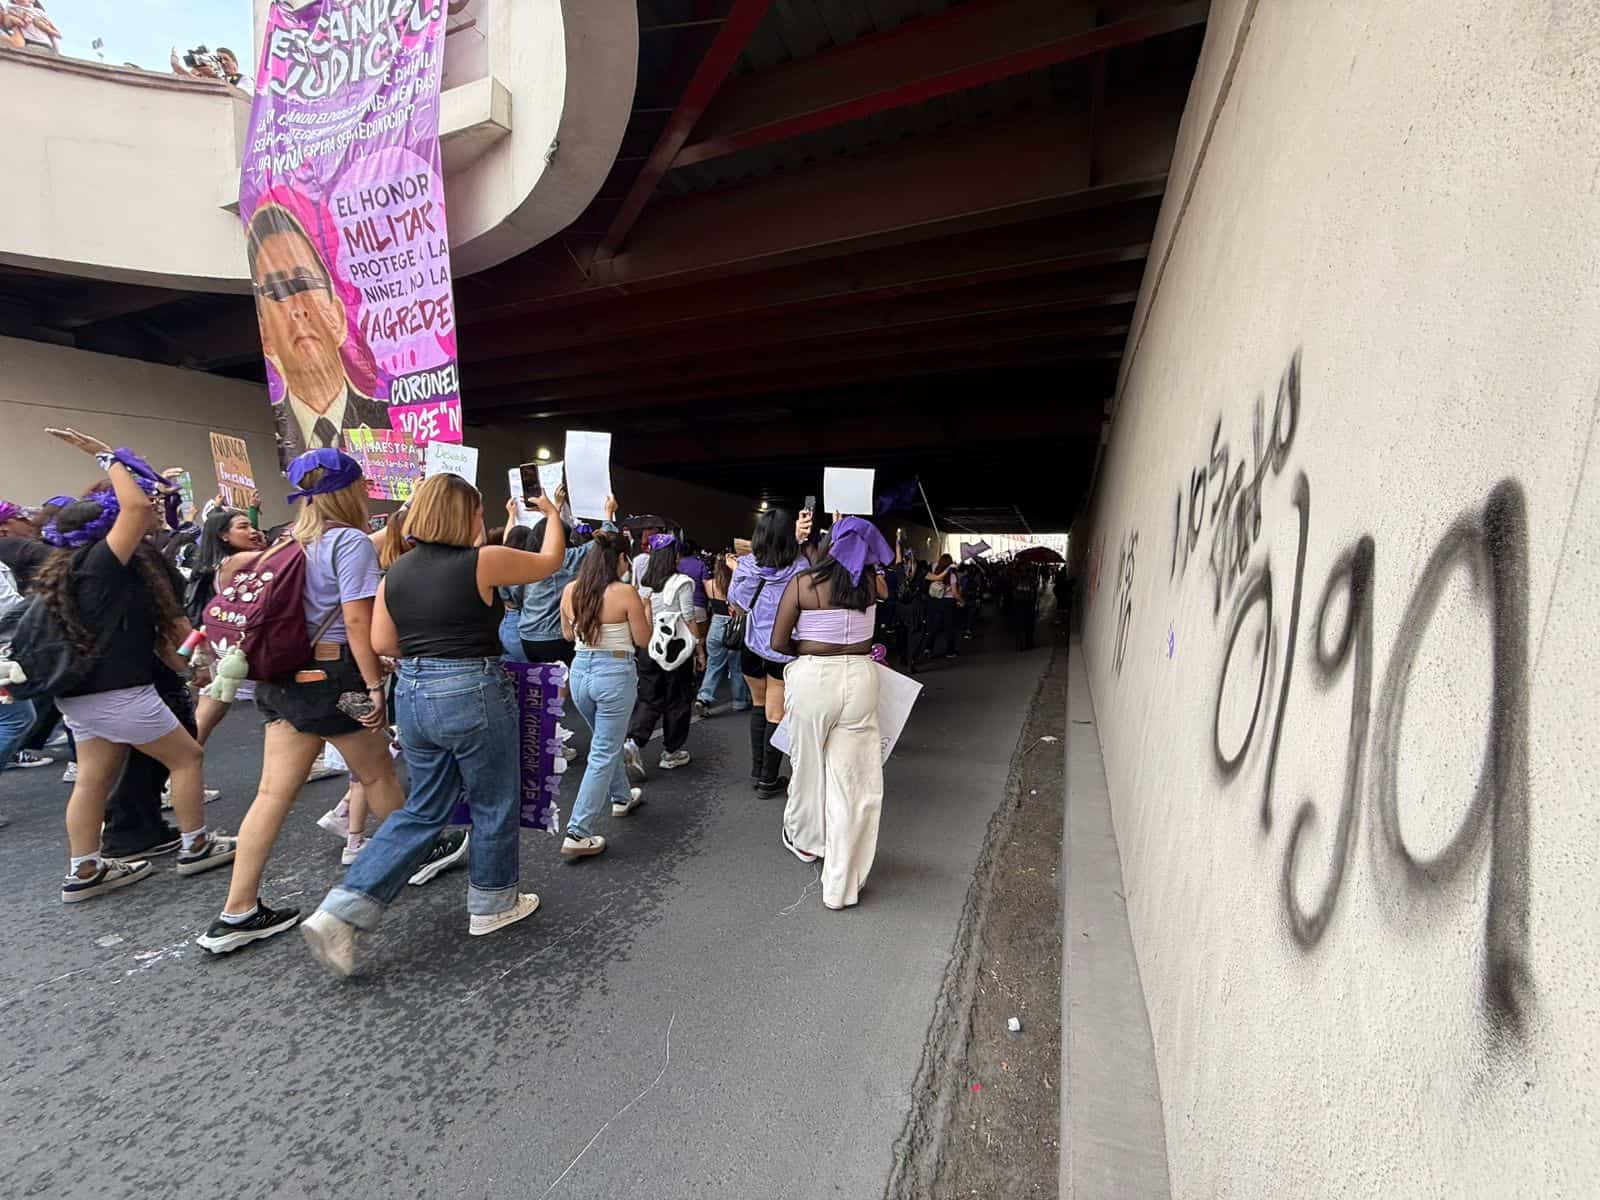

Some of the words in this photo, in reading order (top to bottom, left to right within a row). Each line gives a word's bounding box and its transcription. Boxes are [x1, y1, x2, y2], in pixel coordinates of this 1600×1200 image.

[336, 195, 358, 218] EL
[359, 173, 429, 212] HONOR
[343, 199, 436, 257] MILITAR
[350, 249, 416, 281] PROTEGE
[427, 238, 447, 259] LA
[429, 266, 448, 285] LA
[391, 364, 459, 405] CORONEL
[365, 440, 417, 454] MAESTRA
